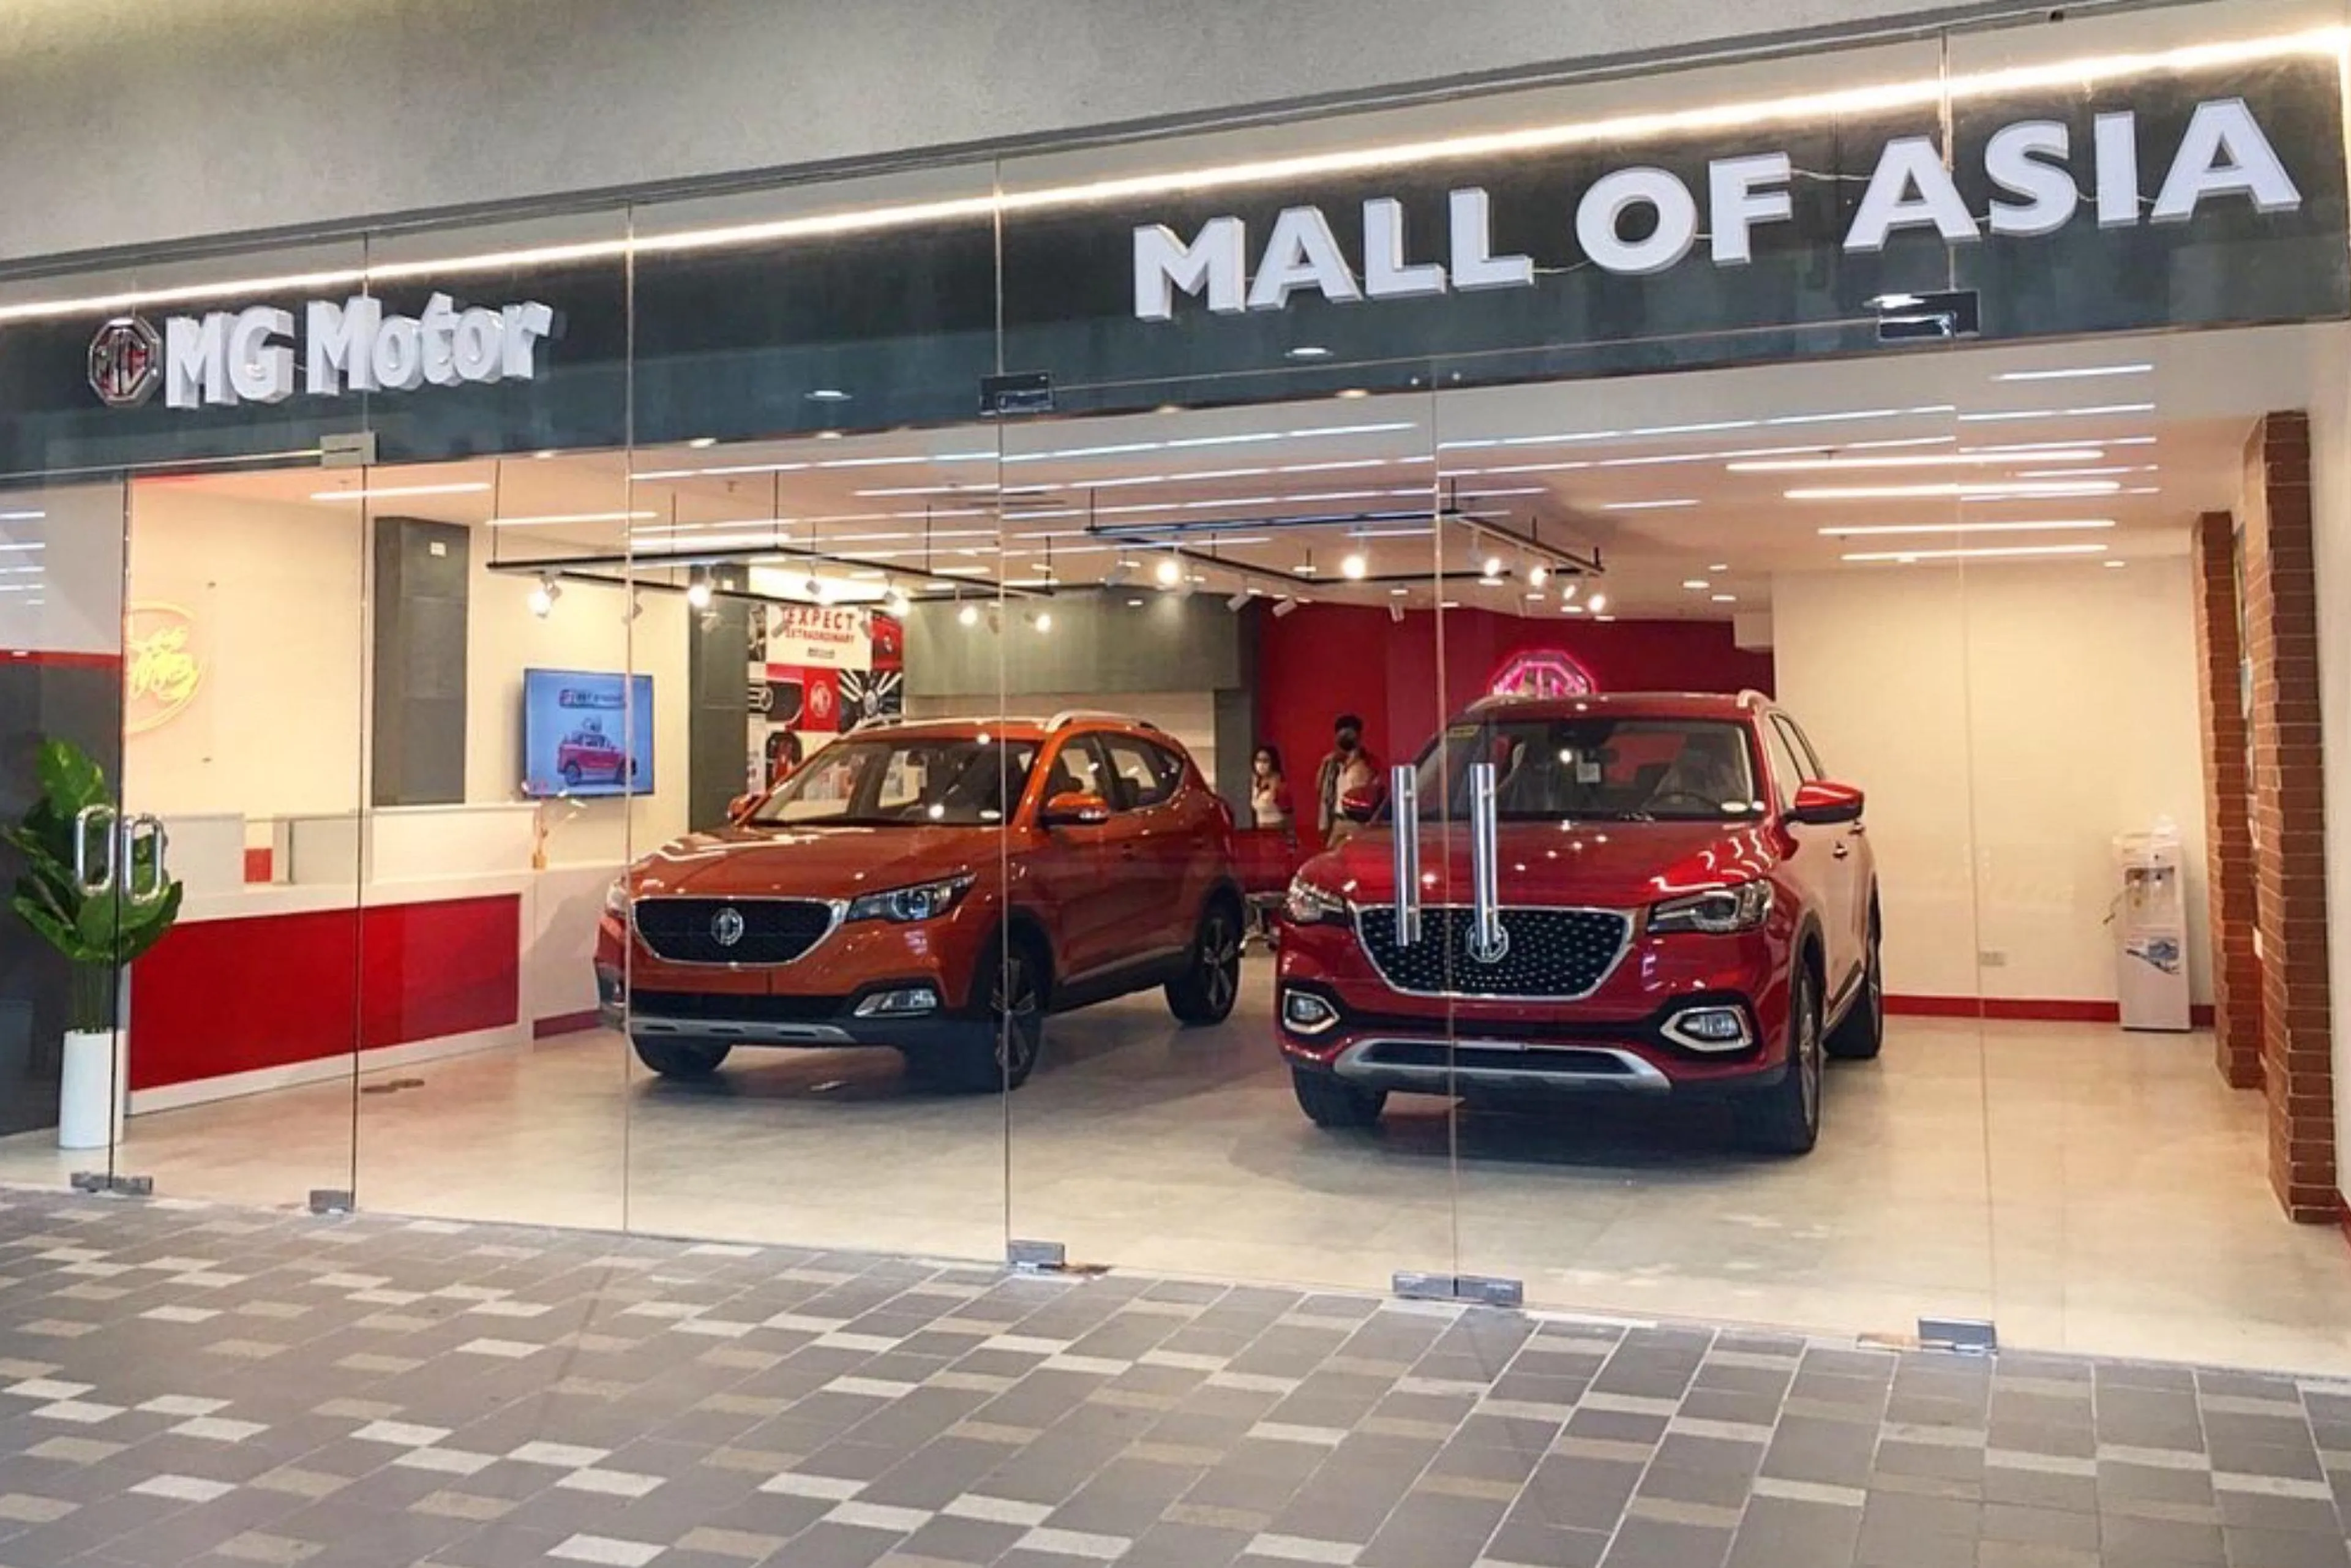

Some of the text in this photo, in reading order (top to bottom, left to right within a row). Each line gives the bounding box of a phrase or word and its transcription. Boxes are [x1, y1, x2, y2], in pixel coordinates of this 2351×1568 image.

[1133, 98, 2301, 322] MALL OF ASIA
[166, 291, 553, 409] MG Motor
[784, 606, 855, 631] EXPECT
